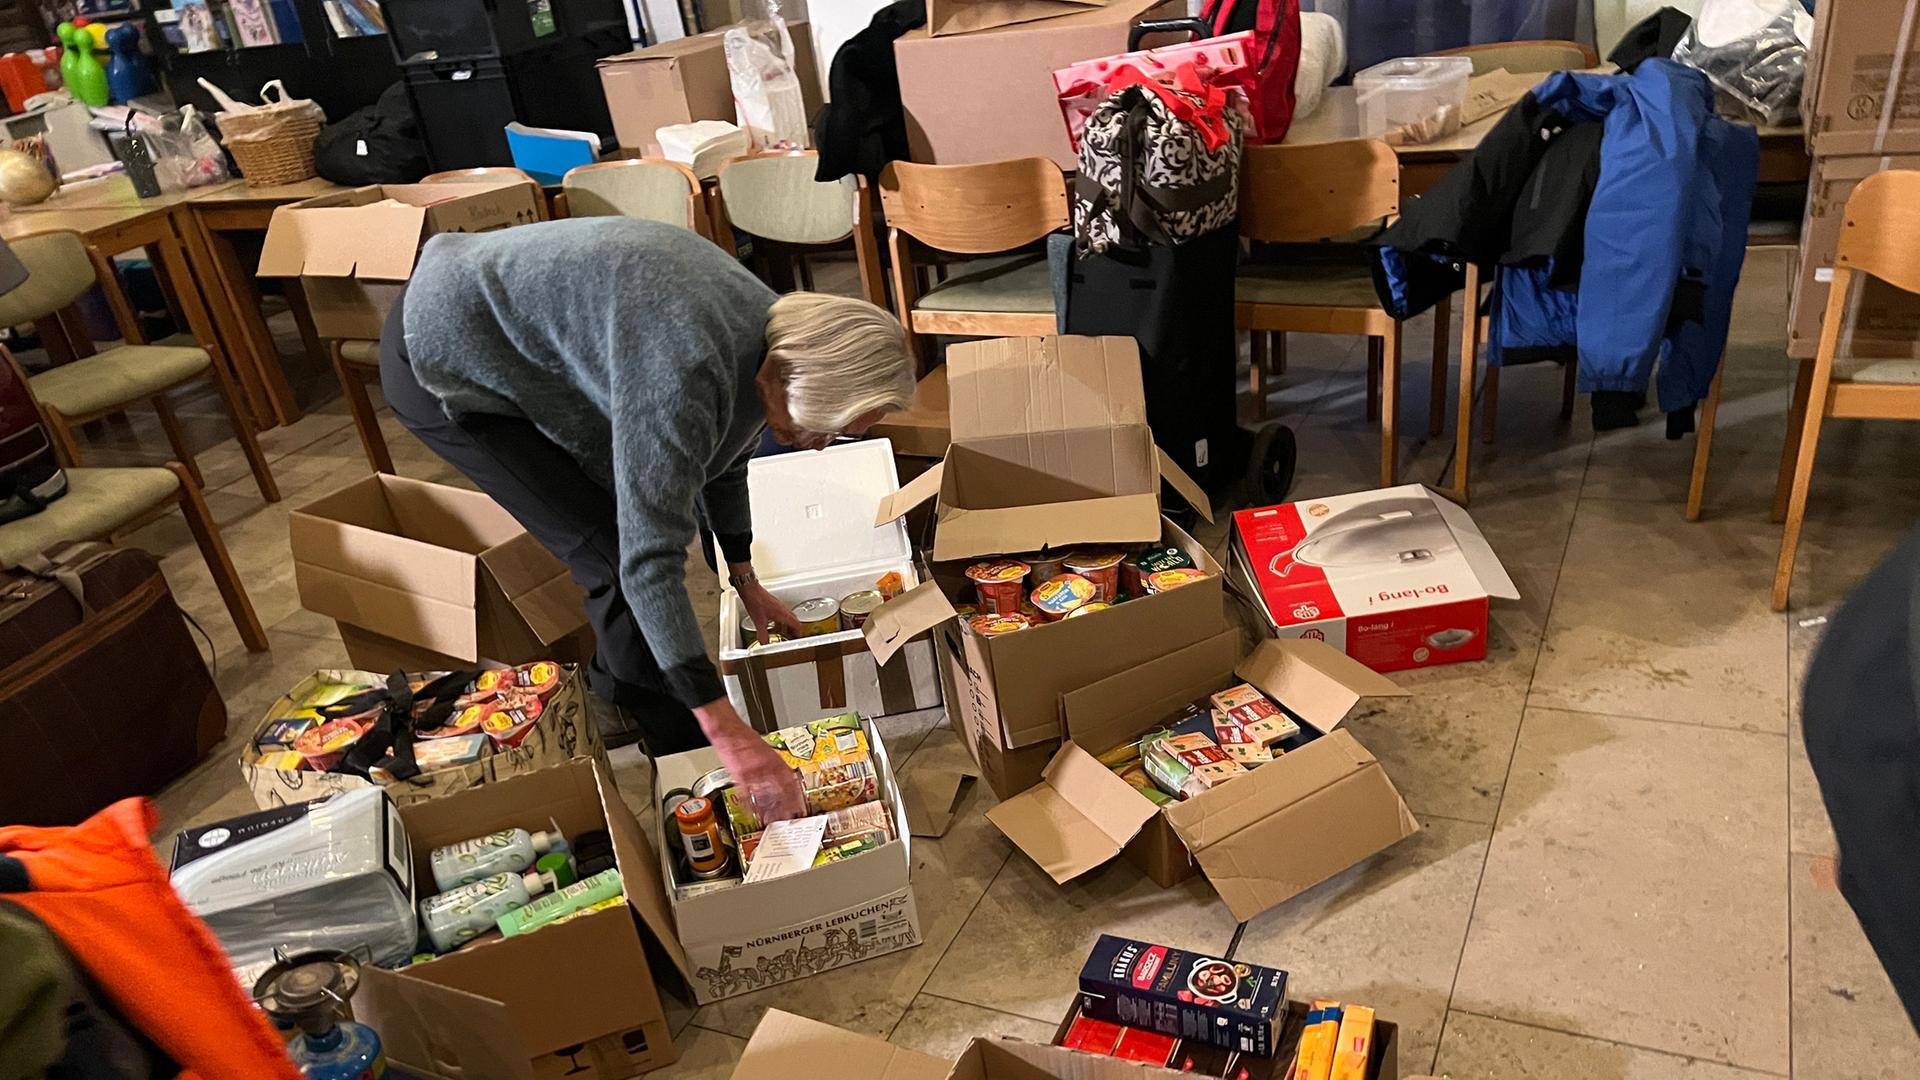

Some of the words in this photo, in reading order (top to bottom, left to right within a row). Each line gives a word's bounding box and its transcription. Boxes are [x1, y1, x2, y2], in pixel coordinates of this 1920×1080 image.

[1378, 584, 1449, 601] Bo-lang
[746, 923, 823, 949] NÜRNBERGER
[825, 902, 890, 928] LEBKUCHEN
[1113, 945, 1138, 979] KRAKUS
